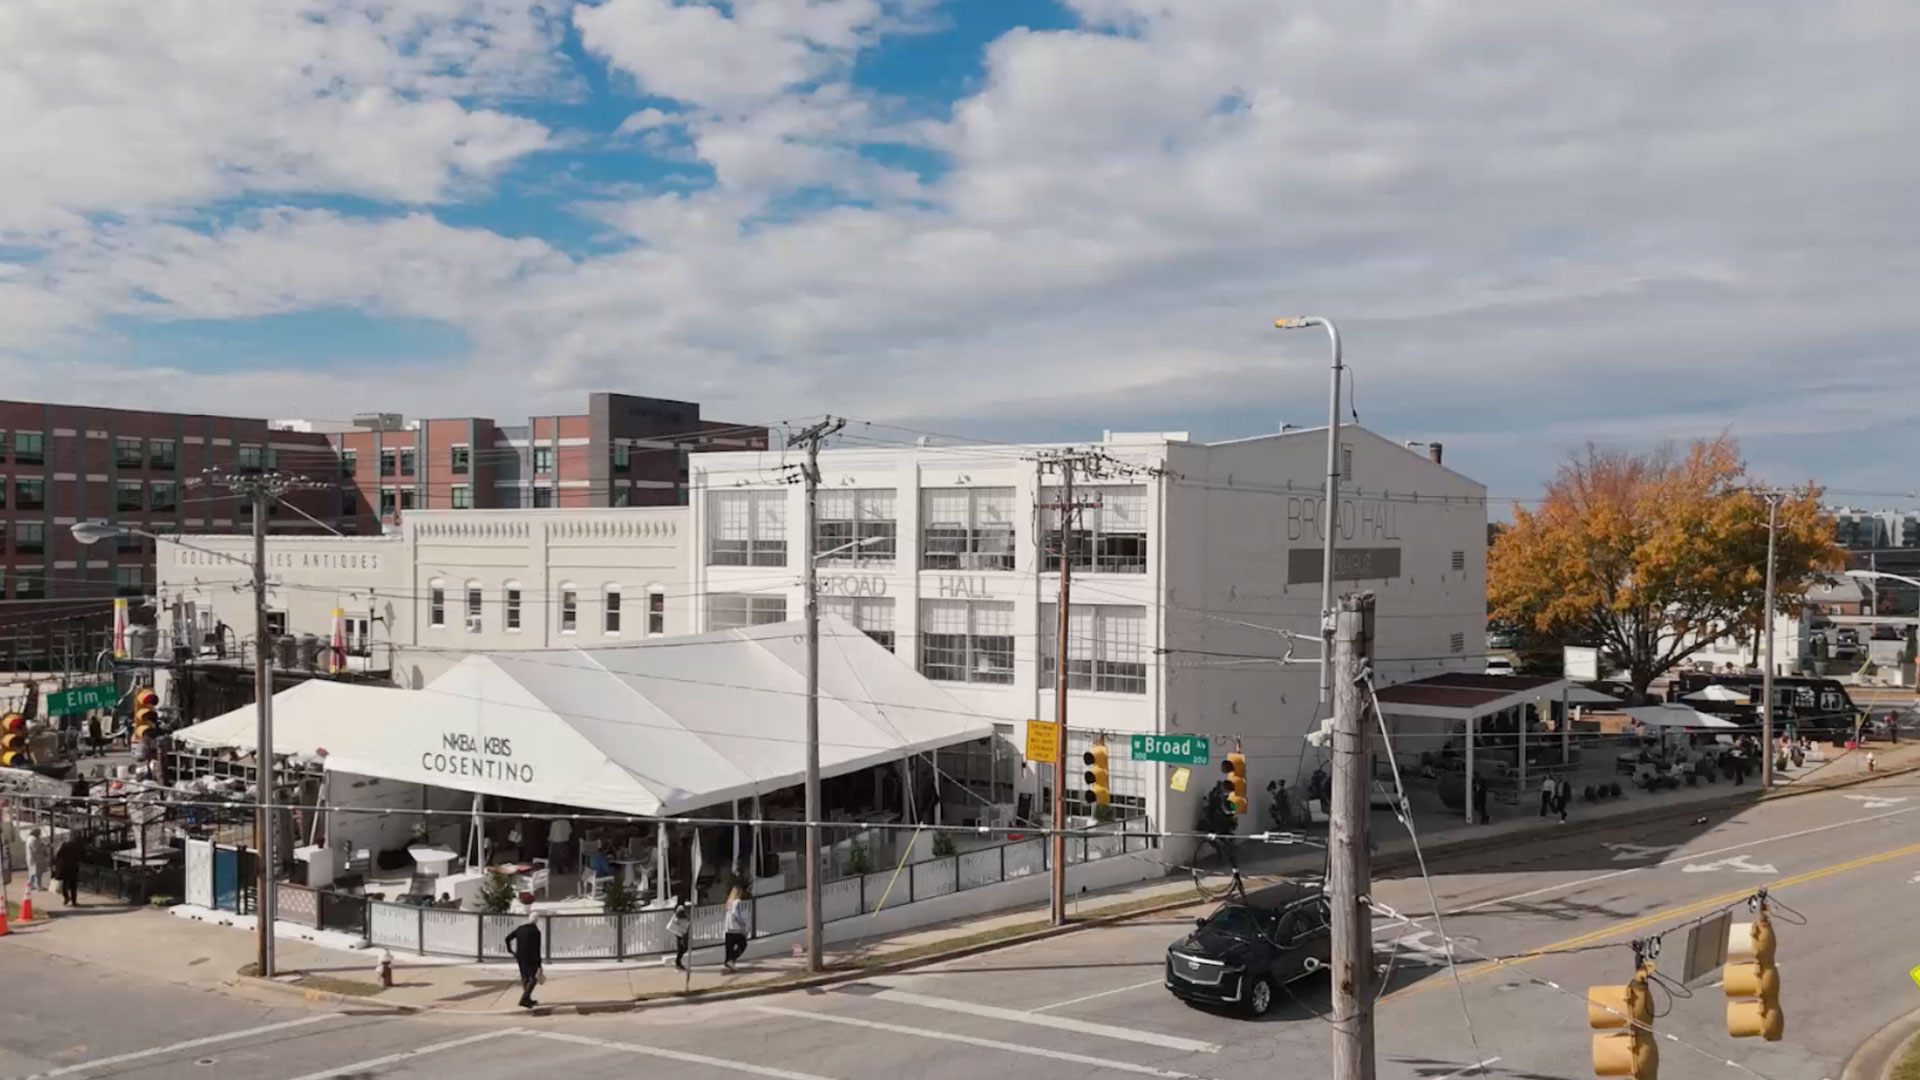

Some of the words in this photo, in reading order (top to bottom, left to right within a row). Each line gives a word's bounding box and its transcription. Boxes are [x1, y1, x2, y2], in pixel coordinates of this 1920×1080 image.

[1287, 497, 1356, 541] BROAD
[1362, 501, 1402, 541] HALL
[302, 553, 377, 569] ANTIQUES
[818, 576, 887, 597] BROAD
[939, 575, 994, 598] HALL
[67, 691, 98, 707] Elm
[442, 733, 478, 753] NKBA
[484, 735, 512, 757] KBIS
[1145, 736, 1191, 756] Broad
[422, 752, 534, 783] COSENTINO
